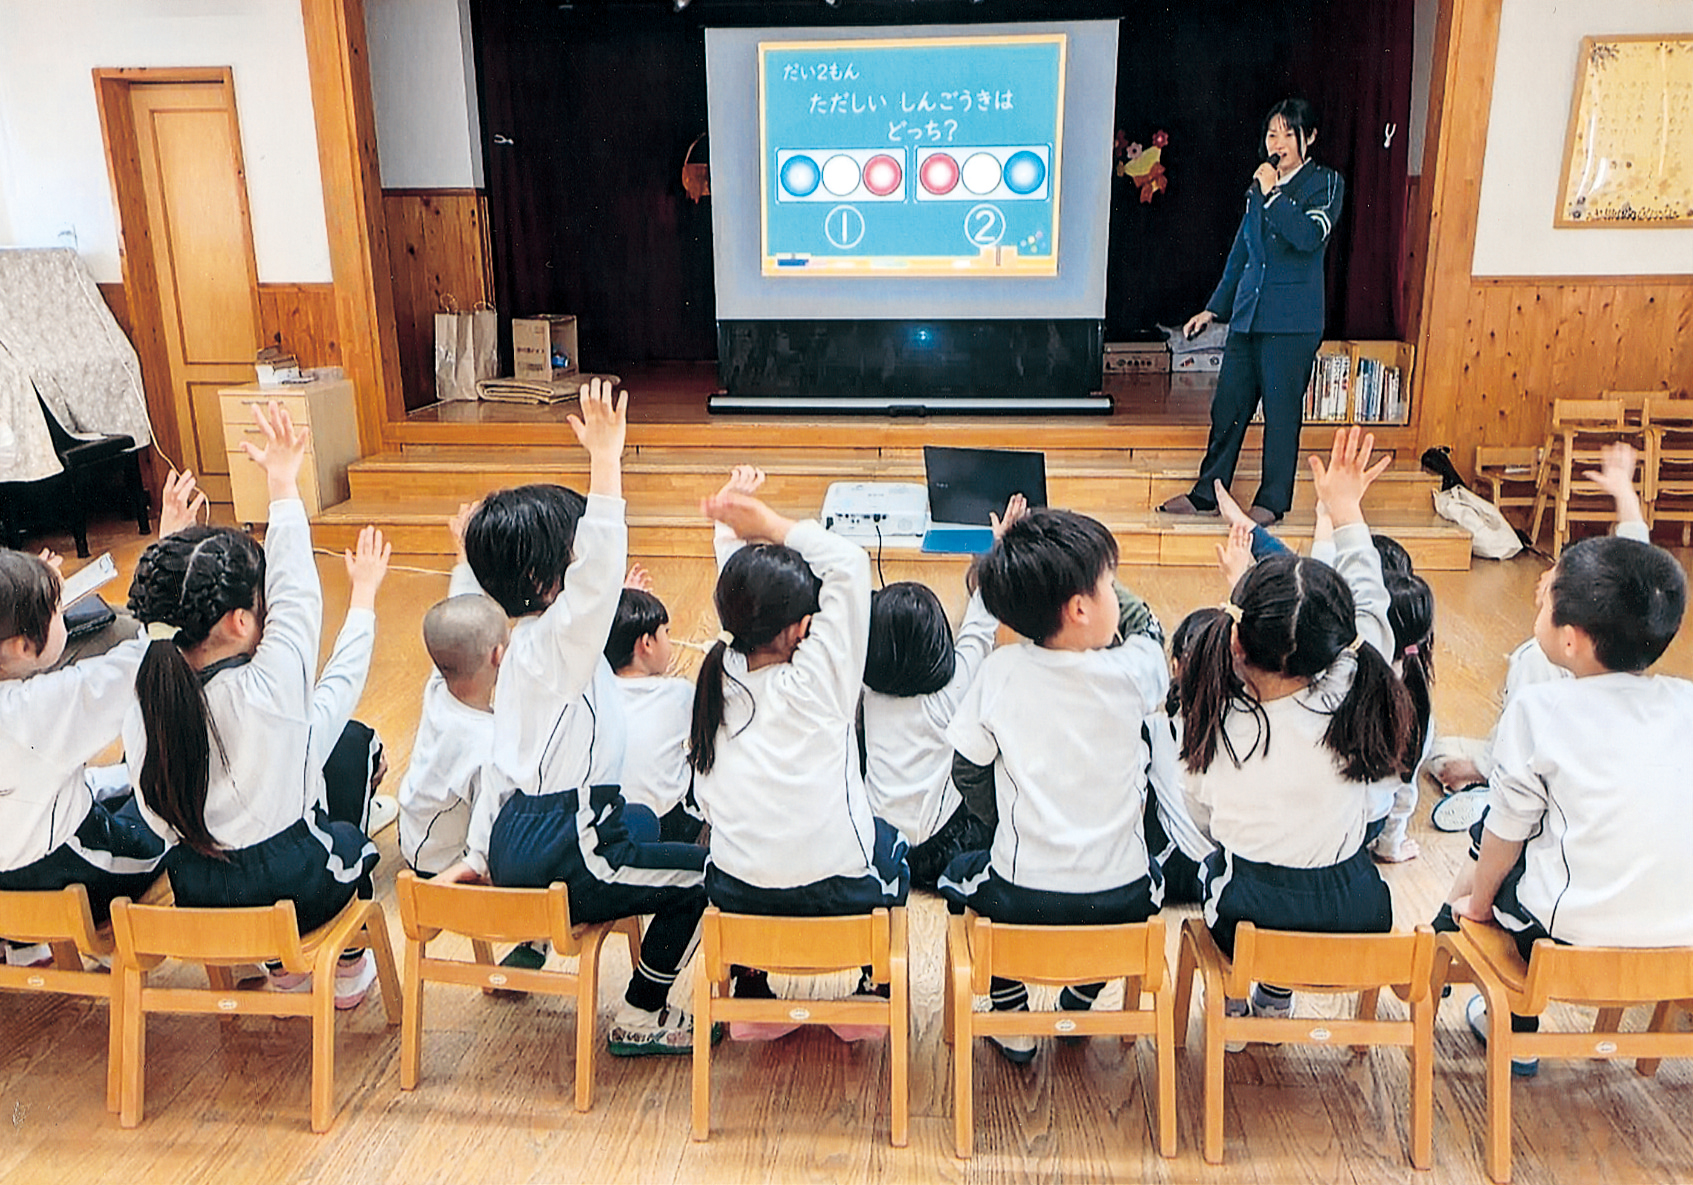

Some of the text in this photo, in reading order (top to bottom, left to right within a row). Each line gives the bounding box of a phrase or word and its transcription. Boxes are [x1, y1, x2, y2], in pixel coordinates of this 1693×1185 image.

[783, 62, 860, 81] だい2もん
[809, 89, 1015, 115] ただしい しんごうきは
[887, 119, 959, 142] どっち?
